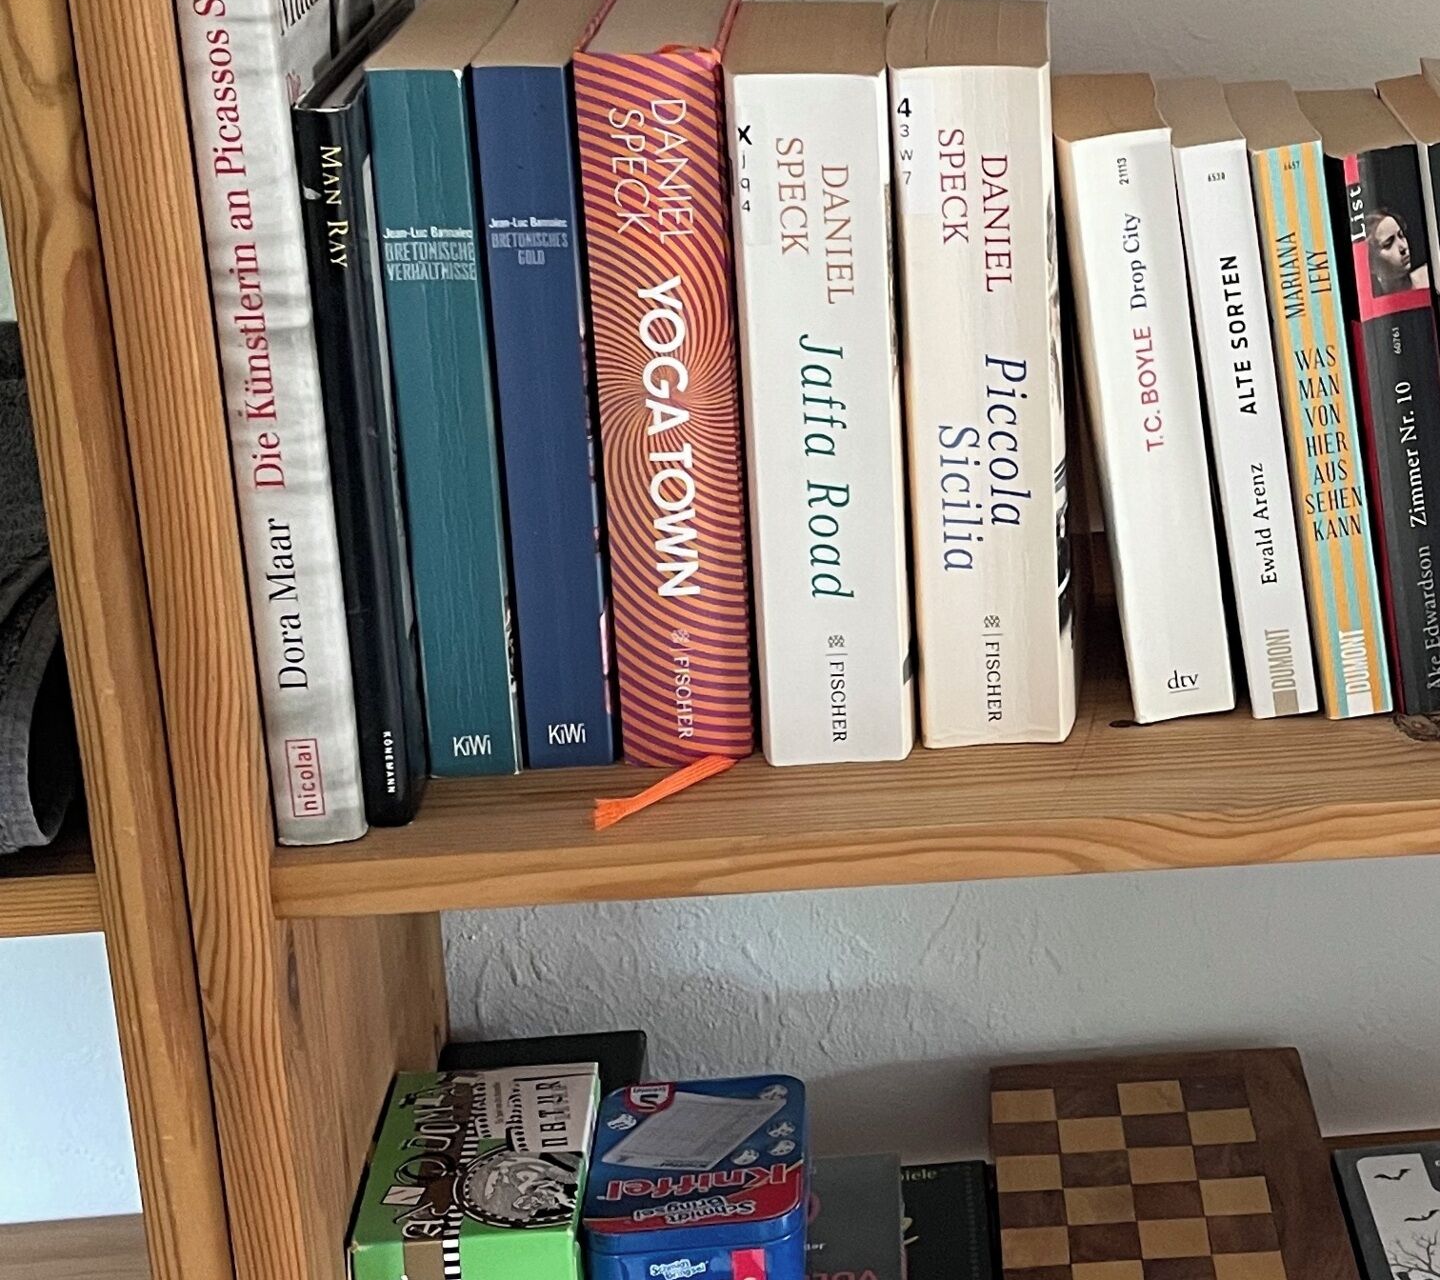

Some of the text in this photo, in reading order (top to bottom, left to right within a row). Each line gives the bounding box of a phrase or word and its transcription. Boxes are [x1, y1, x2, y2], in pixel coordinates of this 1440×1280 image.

[896, 97, 912, 117] 4
[899, 124, 910, 138] 3
[608, 108, 653, 236] SPECK
[650, 98, 695, 245] DANIEL
[775, 136, 810, 257] SPECK
[902, 171, 912, 186] 7
[937, 128, 970, 246] SPECK
[1116, 157, 1130, 185] 21113
[319, 145, 350, 270] MAN RAY
[741, 199, 751, 213] 4
[821, 164, 856, 305] DANIEL
[981, 154, 1014, 293] DANIEL
[1349, 185, 1367, 242] List
[383, 240, 476, 263] BRETONISCHE
[517, 249, 546, 266] GOLD
[1275, 230, 1306, 320] MARIANA
[1306, 248, 1332, 295] LEKY
[206, 28, 309, 691] Dora Maar Die Künstlerin an Picassos
[1122, 212, 1165, 453] T.C. BOYLE Drop City
[1219, 255, 1258, 415] ALTE SORTEN
[1294, 345, 1337, 370] WAS
[1299, 374, 1341, 399] MAN
[1304, 403, 1342, 428] VON
[1394, 381, 1413, 404] 10
[636, 275, 700, 599] YOGA TOWN
[984, 353, 1032, 528] Piccola
[1305, 432, 1348, 458] HIER
[1399, 410, 1418, 444] Nr.
[798, 334, 856, 600] Jaffa Road
[937, 424, 985, 573] Sicilia
[1313, 459, 1349, 486] AUS
[1406, 448, 1428, 529] Zimmer
[1250, 462, 1278, 585] Ewald Arenz
[1304, 485, 1364, 515] SEHEN
[1313, 514, 1363, 543] KANN
[984, 641, 1004, 723] FISCHER
[1166, 669, 1200, 690] dtv
[1264, 628, 1297, 691] DUMONT
[1338, 629, 1372, 695] DUMONT
[673, 655, 695, 740] FISCHER
[828, 660, 849, 744] FISCHER
[289, 742, 320, 812] nicolai
[382, 730, 396, 795] KÖNEMANN
[605, 1163, 787, 1201] Kniffel
